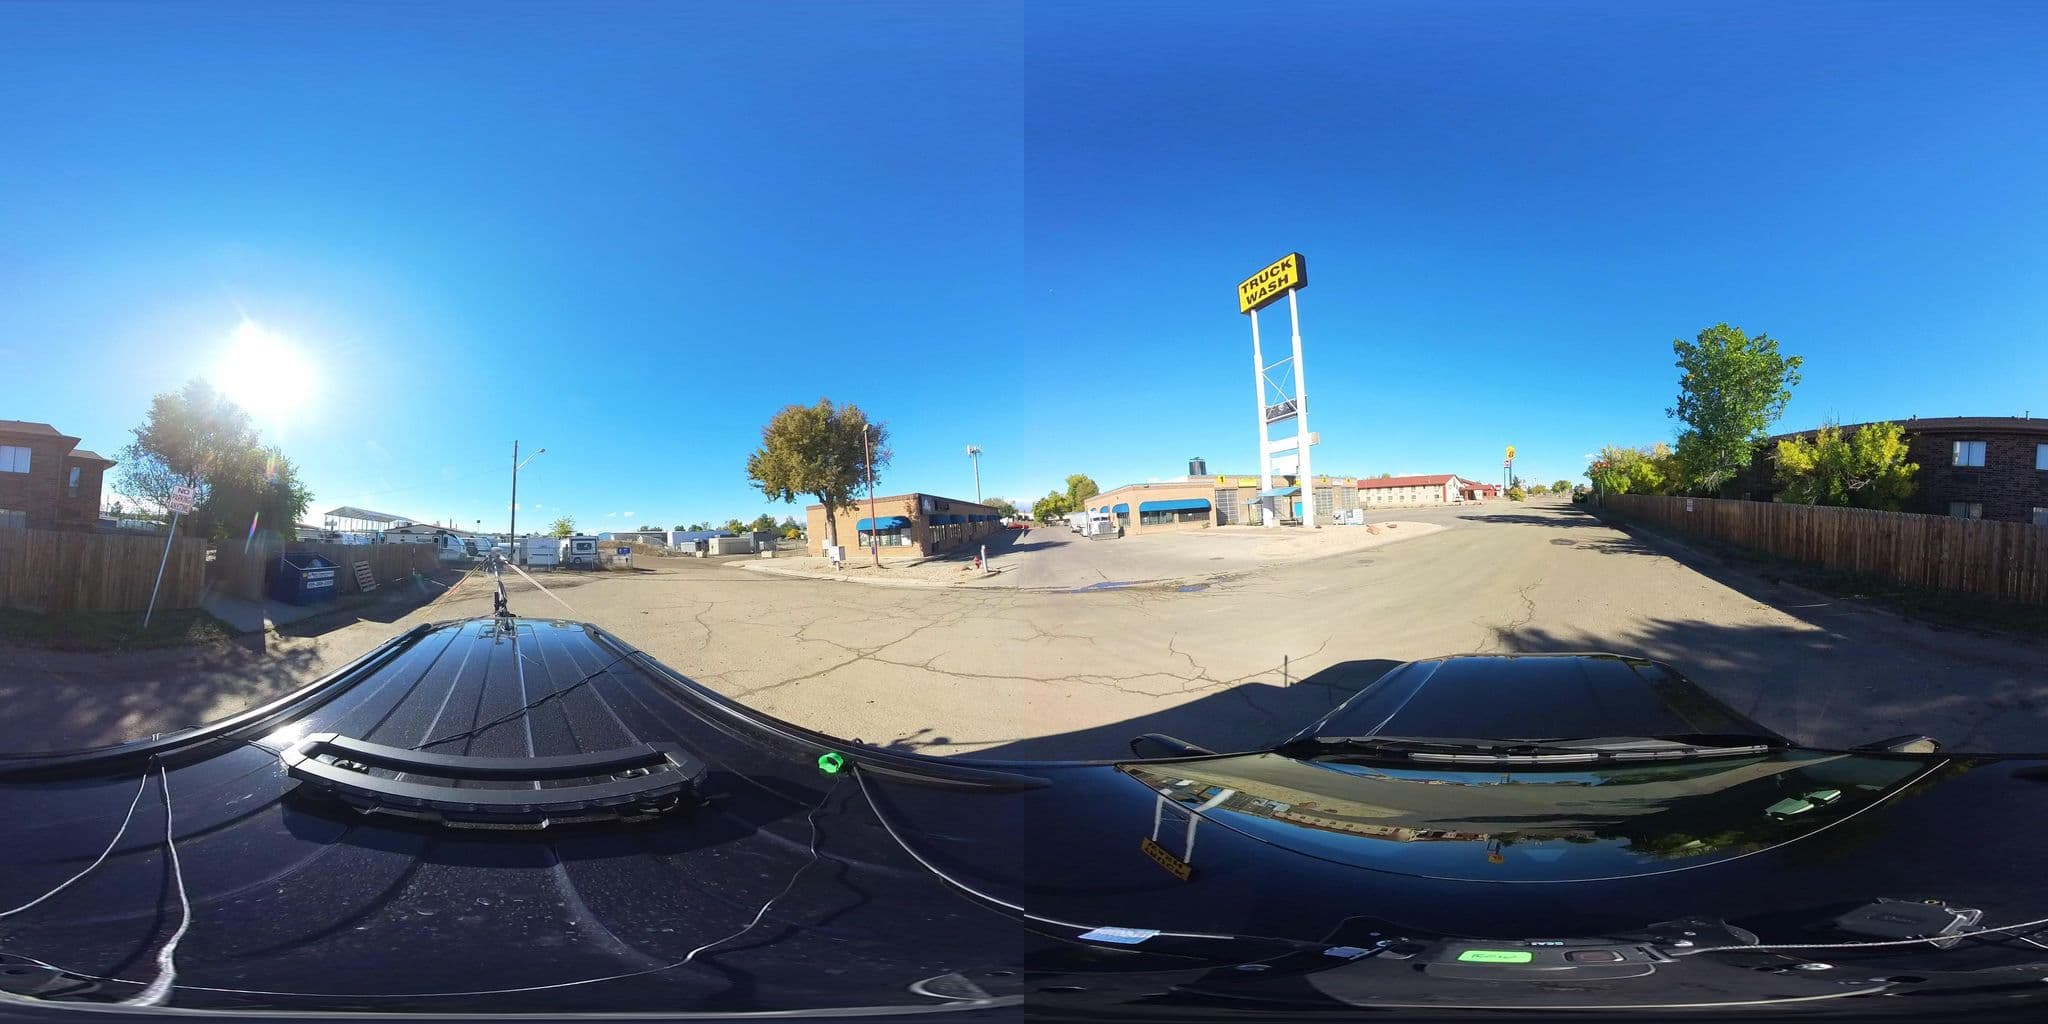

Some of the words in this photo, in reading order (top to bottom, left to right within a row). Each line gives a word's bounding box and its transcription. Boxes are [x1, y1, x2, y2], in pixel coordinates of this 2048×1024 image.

[1241, 258, 1293, 293] TRUCK
[1246, 274, 1289, 305] WASH
[177, 487, 190, 495] NO
